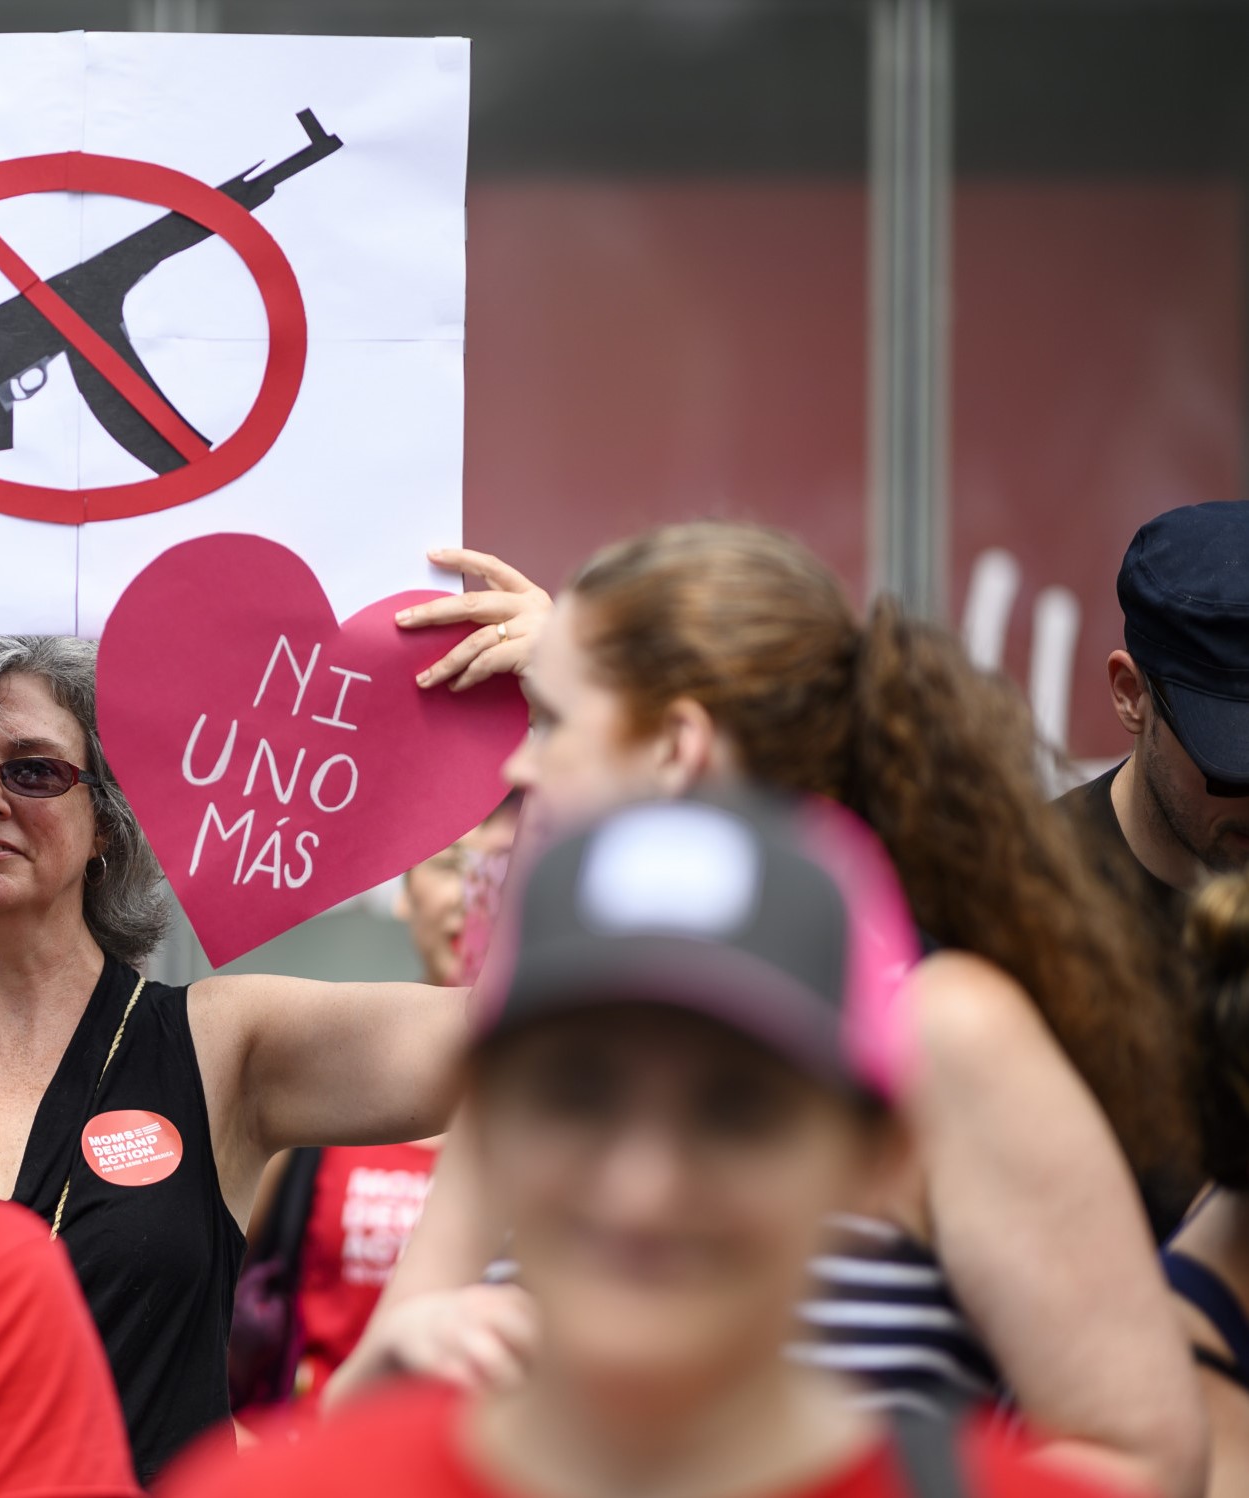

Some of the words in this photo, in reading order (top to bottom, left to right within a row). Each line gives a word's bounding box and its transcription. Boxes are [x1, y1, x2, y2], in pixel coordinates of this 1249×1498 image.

[253, 634, 372, 731] NI
[181, 713, 359, 813] UNO
[189, 802, 320, 889] MÁS
[88, 1131, 134, 1146] MOMS
[92, 1134, 158, 1157] DEMAND
[98, 1145, 155, 1167] ACTION
